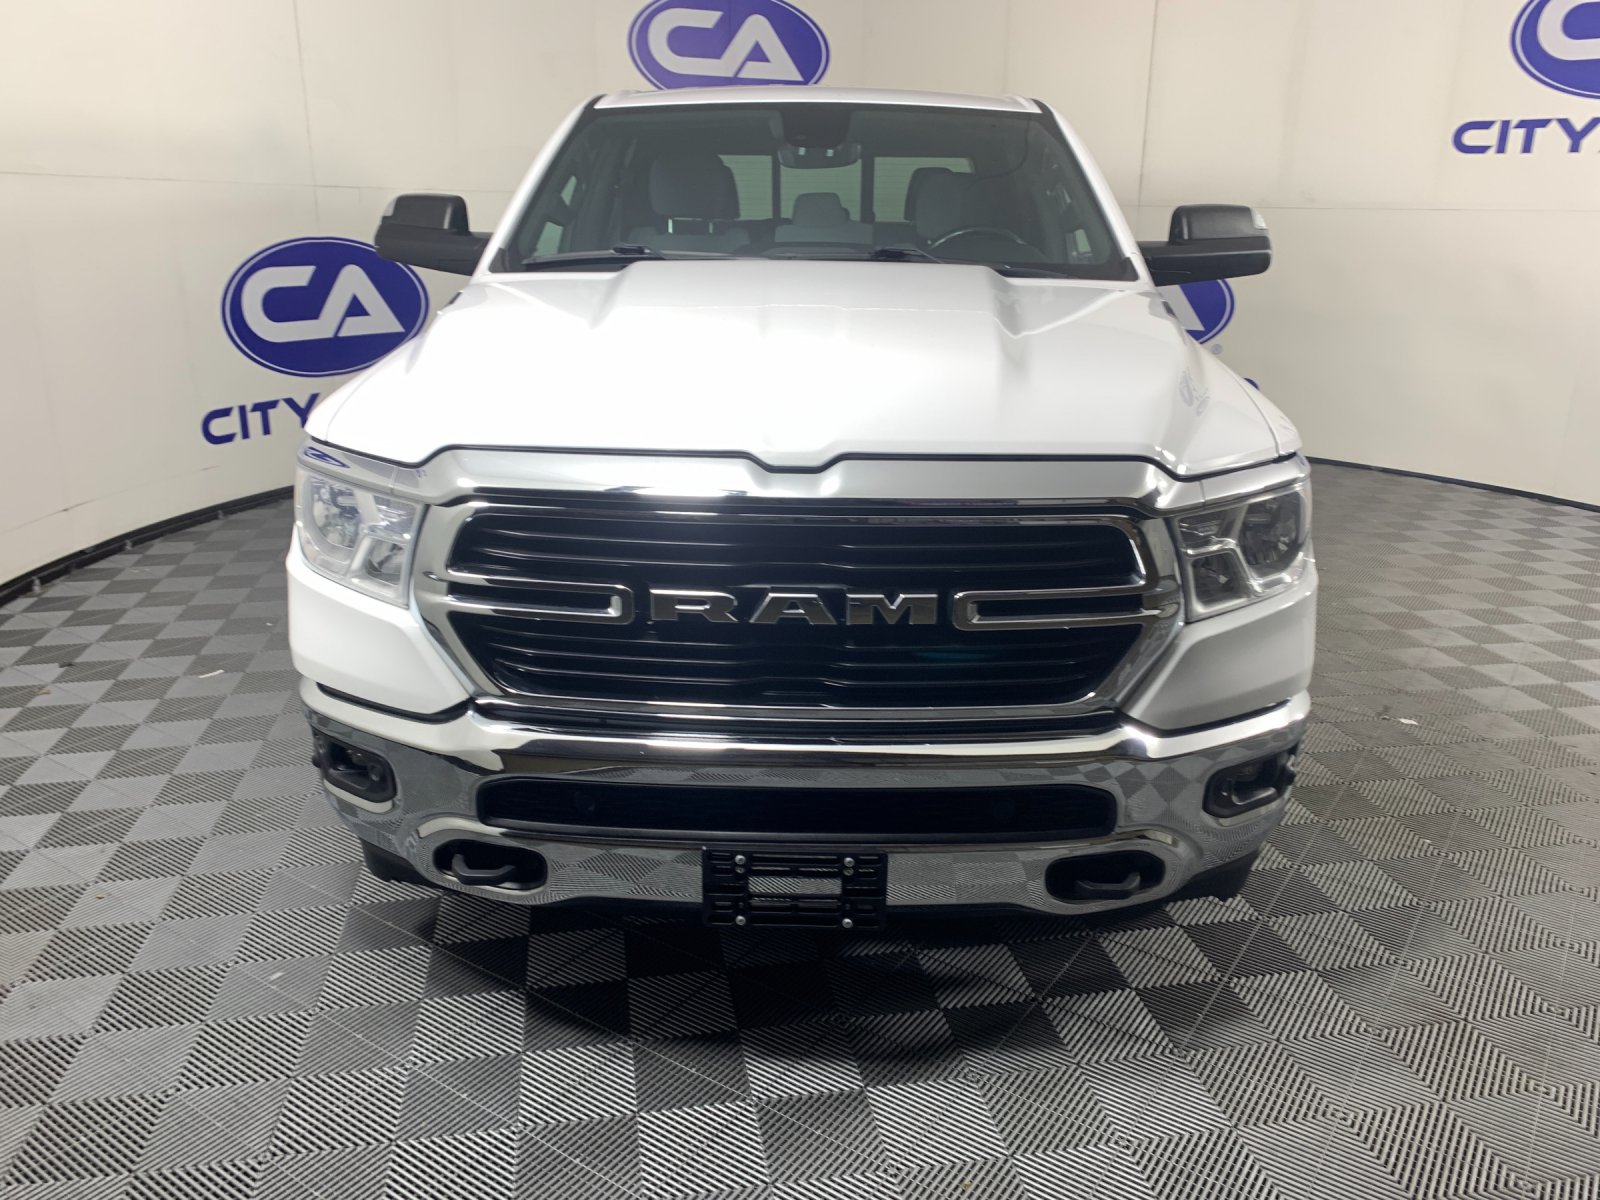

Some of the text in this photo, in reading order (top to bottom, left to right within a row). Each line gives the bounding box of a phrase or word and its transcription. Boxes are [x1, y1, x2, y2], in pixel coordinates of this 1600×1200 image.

[647, 8, 805, 81] CA
[241, 264, 406, 343] CA
[202, 392, 320, 445] CITY
[649, 588, 938, 626] RAM
